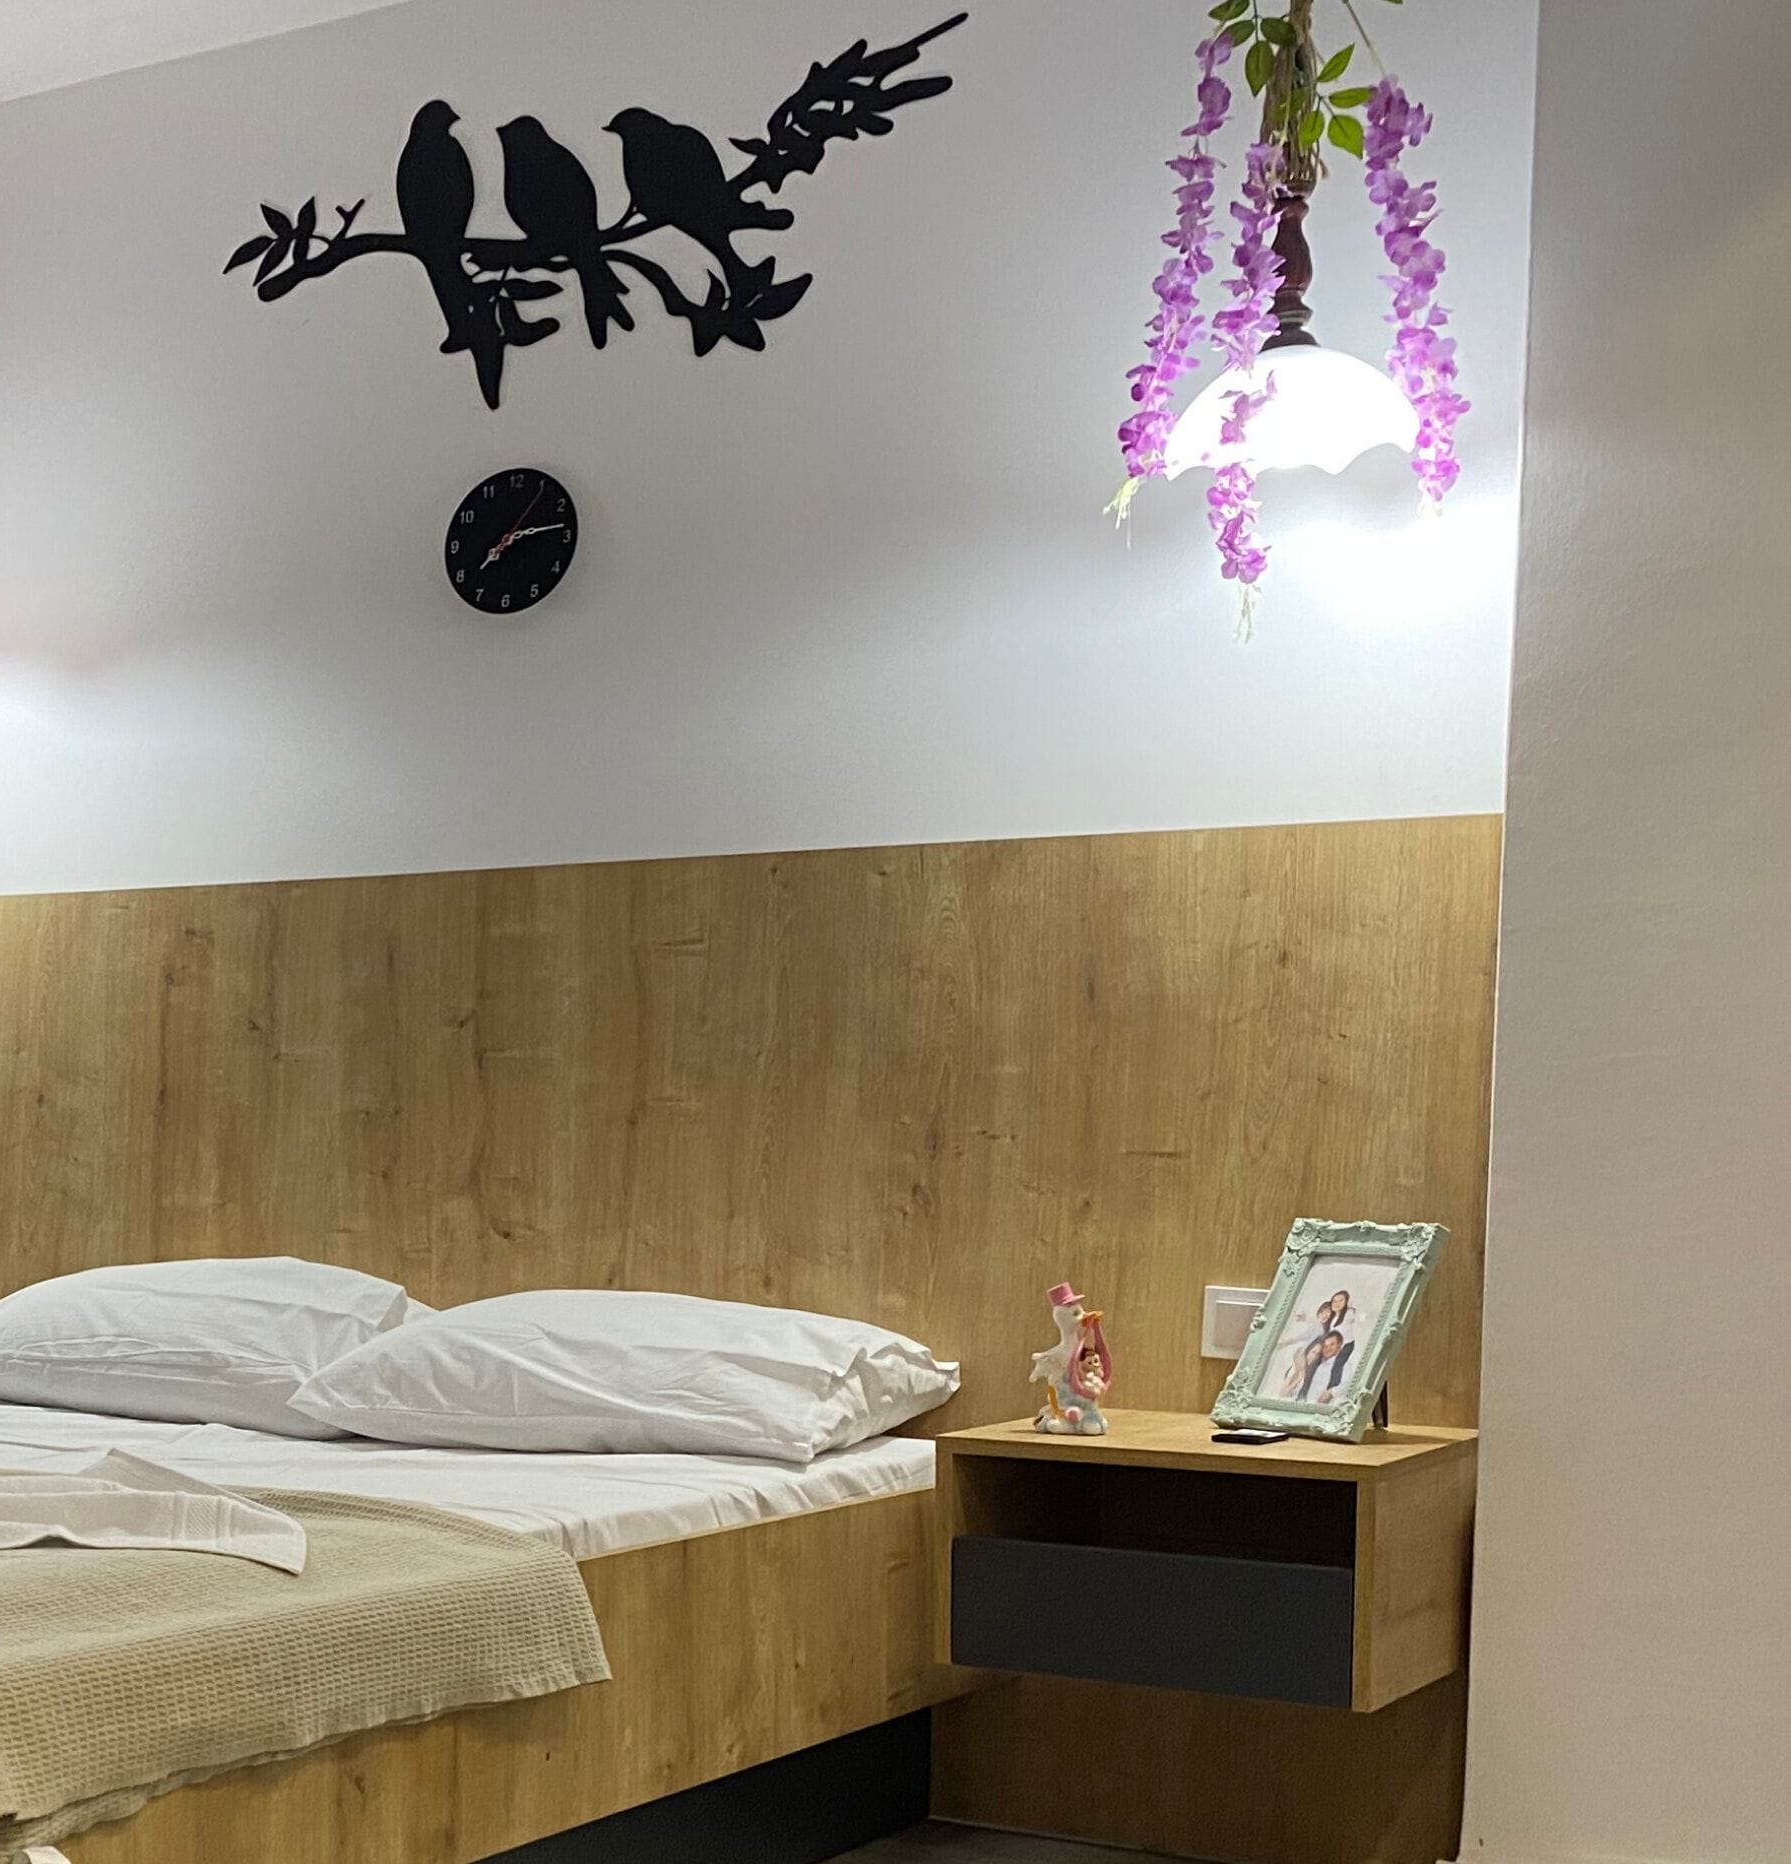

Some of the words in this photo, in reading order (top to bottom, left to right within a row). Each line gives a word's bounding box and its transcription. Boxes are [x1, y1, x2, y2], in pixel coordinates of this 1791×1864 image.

[510, 474, 524, 488] 12
[483, 485, 494, 498] 11
[557, 499, 565, 512] 2
[460, 510, 474, 524] 10
[563, 530, 570, 543] 3
[451, 540, 459, 553] 9
[551, 561, 560, 573] 4
[456, 570, 464, 583] 8
[476, 589, 484, 601] 7
[530, 584, 538, 597] 5
[501, 595, 510, 607] 6
